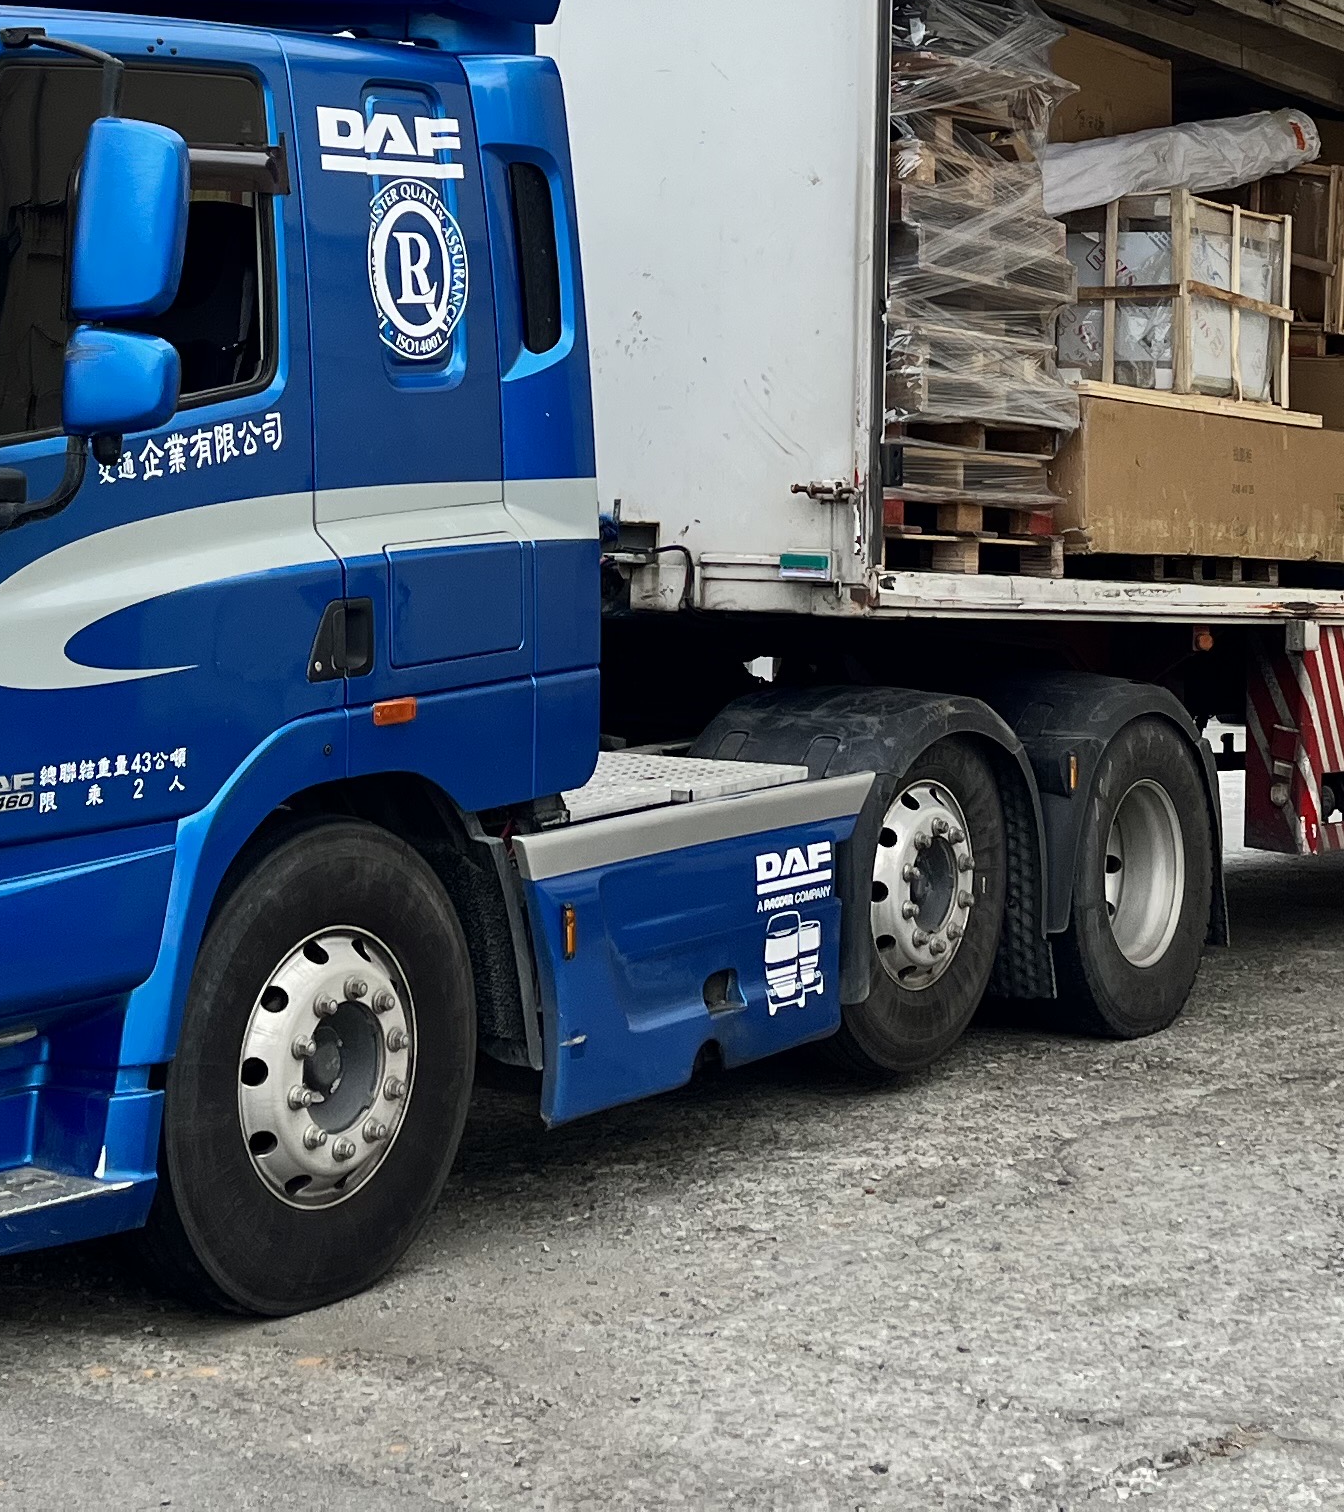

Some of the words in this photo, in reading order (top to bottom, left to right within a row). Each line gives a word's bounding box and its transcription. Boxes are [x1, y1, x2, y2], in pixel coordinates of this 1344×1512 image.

[316, 106, 462, 157] DAF
[395, 332, 444, 355] ISO14001
[756, 841, 832, 882] DAF
[757, 900, 764, 913] A
[794, 884, 832, 904] COMPANY
